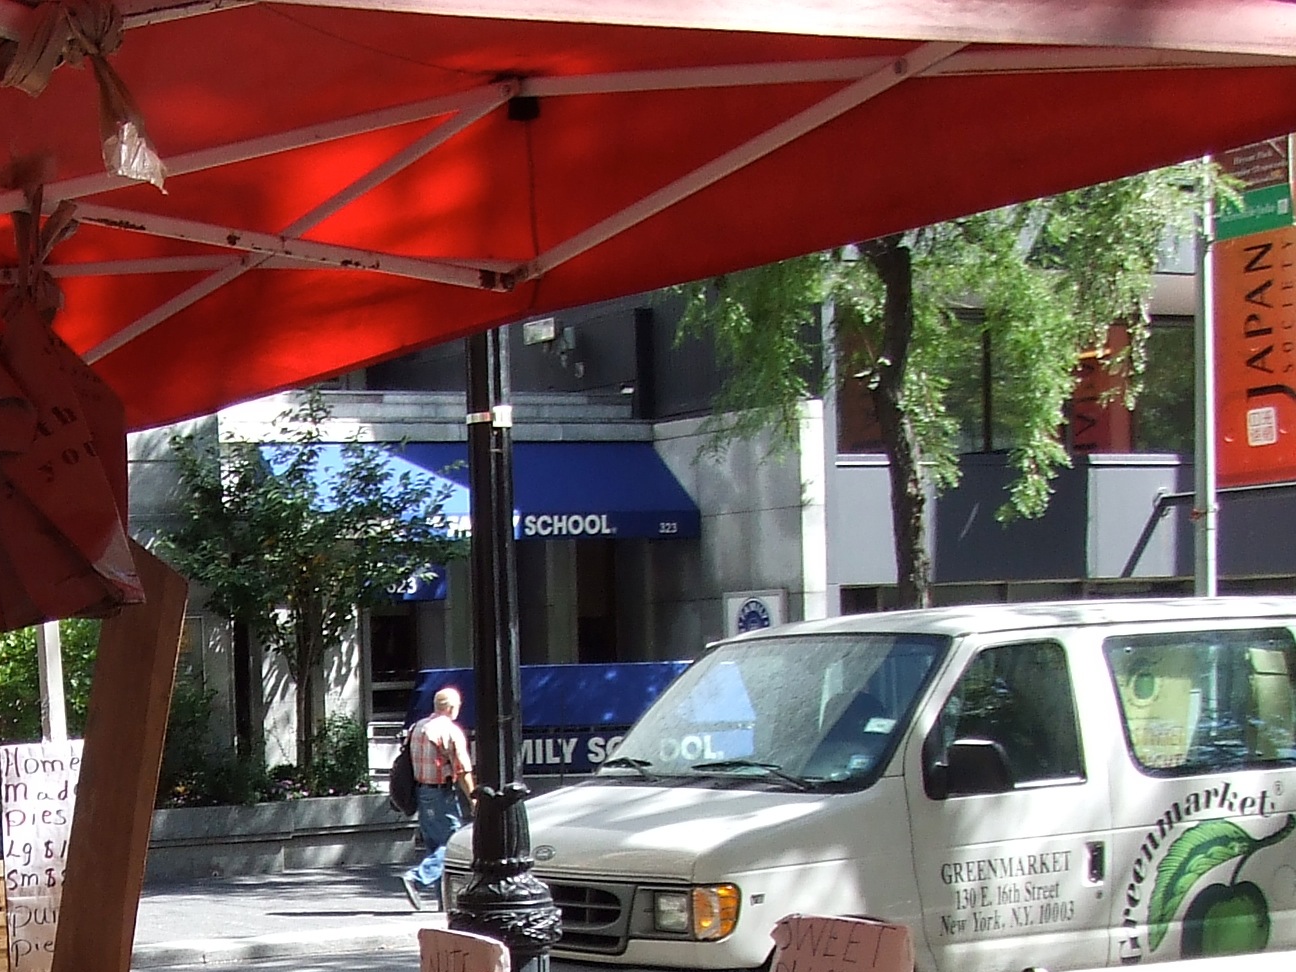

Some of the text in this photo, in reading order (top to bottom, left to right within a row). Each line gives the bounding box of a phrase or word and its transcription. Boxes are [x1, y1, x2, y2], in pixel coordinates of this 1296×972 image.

[1243, 242, 1296, 398] JAPAN
[659, 522, 678, 534] 323
[4, 747, 81, 778] Home
[520, 737, 578, 765] MILY
[940, 850, 1072, 885] GREENMARKET
[956, 887, 977, 910] 130
[997, 883, 1021, 906] 16th
[1024, 881, 1060, 902] Street
[939, 914, 967, 936] New
[1038, 900, 1075, 925] 10003
